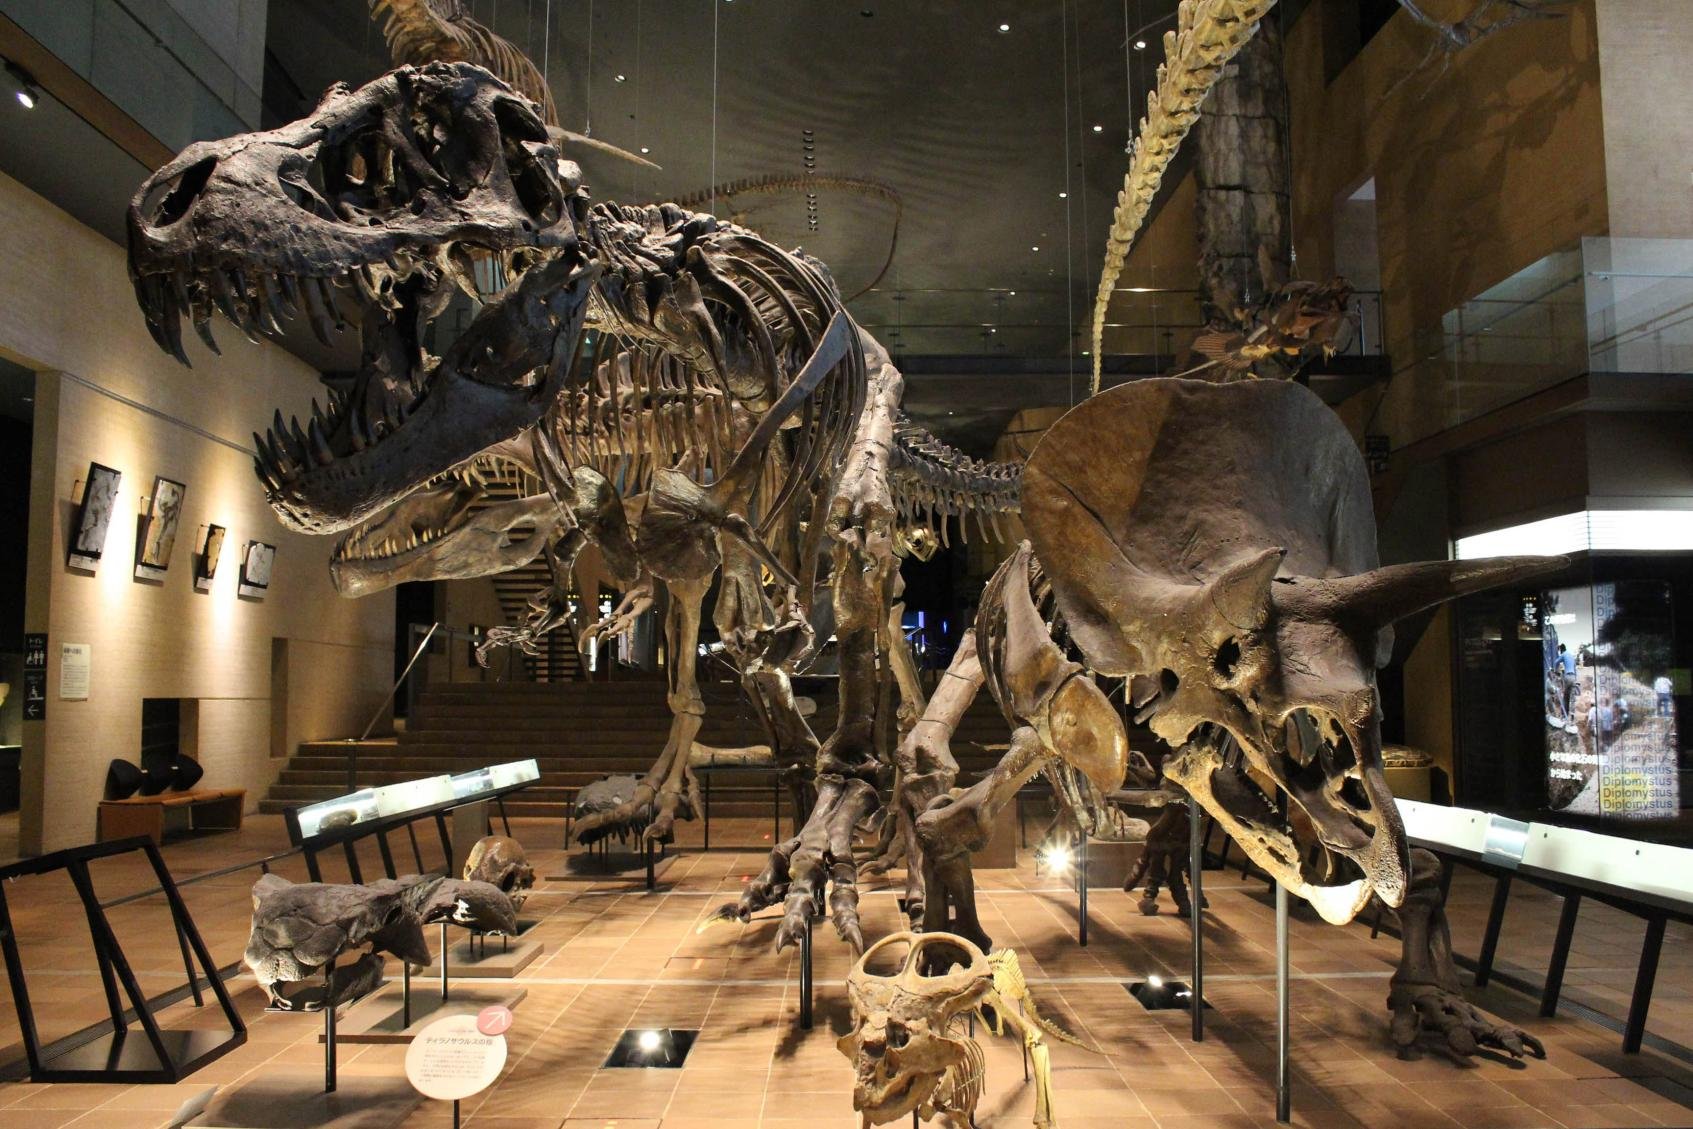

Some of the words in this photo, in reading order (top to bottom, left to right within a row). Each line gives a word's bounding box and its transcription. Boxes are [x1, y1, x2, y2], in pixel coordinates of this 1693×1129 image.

[1602, 765, 1672, 776] Diplomystus
[1602, 776, 1672, 788] Diplomystus
[1603, 788, 1673, 799] Diplomystus
[1603, 799, 1673, 811] Diplomystus
